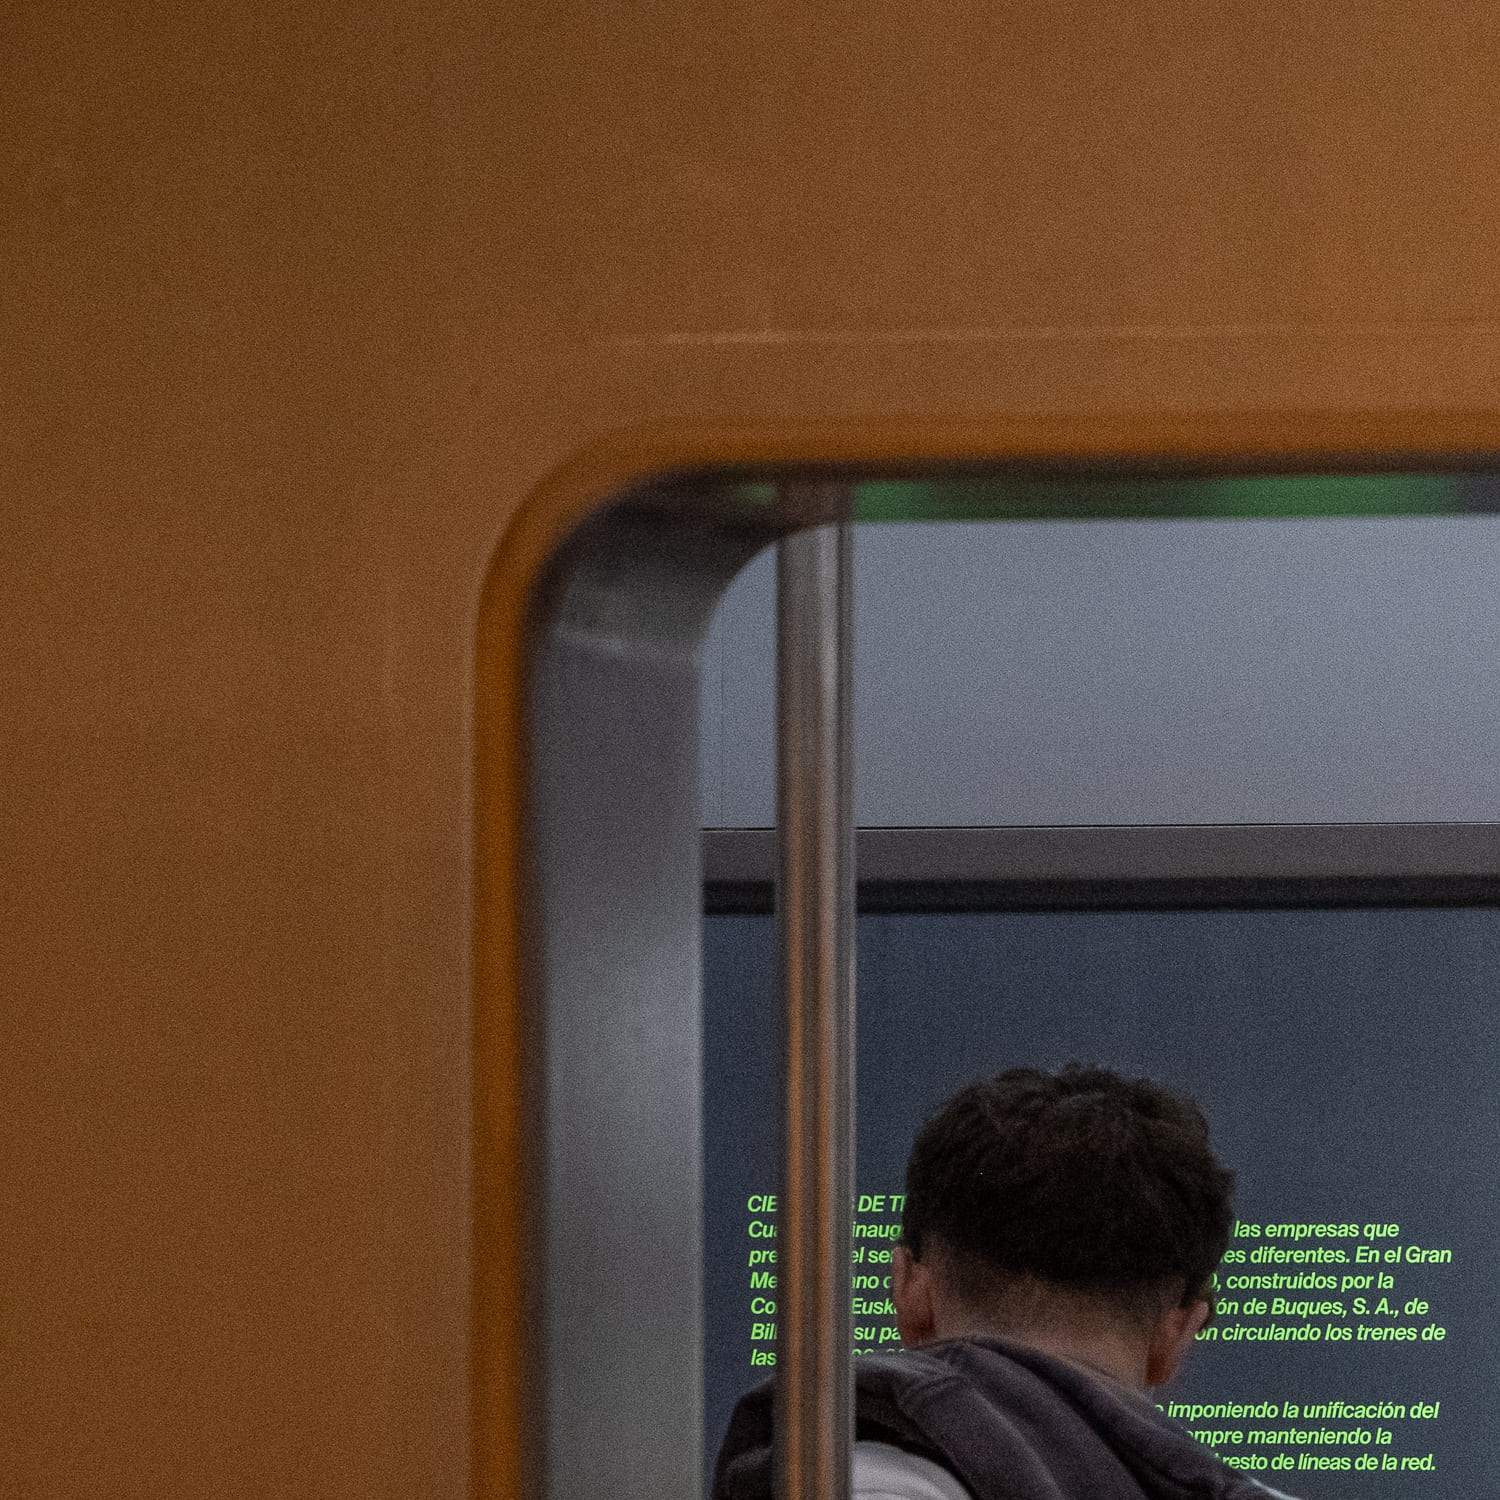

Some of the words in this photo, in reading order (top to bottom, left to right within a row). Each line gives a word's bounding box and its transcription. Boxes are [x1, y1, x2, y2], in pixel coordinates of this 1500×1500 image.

[747, 1194, 777, 1213] CIE
[857, 1194, 887, 1213] DE
[1233, 1219, 1262, 1239] las
[1264, 1223, 1360, 1242] empresas
[1362, 1223, 1401, 1242] que
[1249, 1245, 1351, 1265] diferentes.
[1354, 1245, 1381, 1264] En
[1383, 1245, 1403, 1264] el
[1404, 1244, 1453, 1264] Gran
[1225, 1271, 1339, 1290] construidos
[1340, 1274, 1375, 1294] por
[1376, 1271, 1395, 1290] la
[1242, 1297, 1268, 1316] de
[1270, 1297, 1348, 1320] Buques,
[1351, 1297, 1371, 1316] S.
[1373, 1297, 1400, 1319] A.,
[1403, 1297, 1430, 1316] de
[852, 1326, 877, 1341] su
[1221, 1322, 1322, 1342] circulando
[1323, 1322, 1353, 1342] los
[1356, 1323, 1419, 1342] trenes
[1420, 1322, 1447, 1342] de
[750, 1347, 777, 1367] las
[1167, 1400, 1280, 1423] imponiendo
[1281, 1400, 1300, 1419] la
[1302, 1400, 1407, 1420] unificación
[1409, 1400, 1441, 1420] del
[1246, 1426, 1373, 1446] manteniendo
[1374, 1426, 1393, 1445] la
[1221, 1453, 1269, 1471] resto
[1270, 1452, 1296, 1471] de
[1297, 1452, 1352, 1471] líneas
[1354, 1452, 1380, 1471] de
[1380, 1452, 1399, 1471] la
[1400, 1452, 1437, 1472] red.
